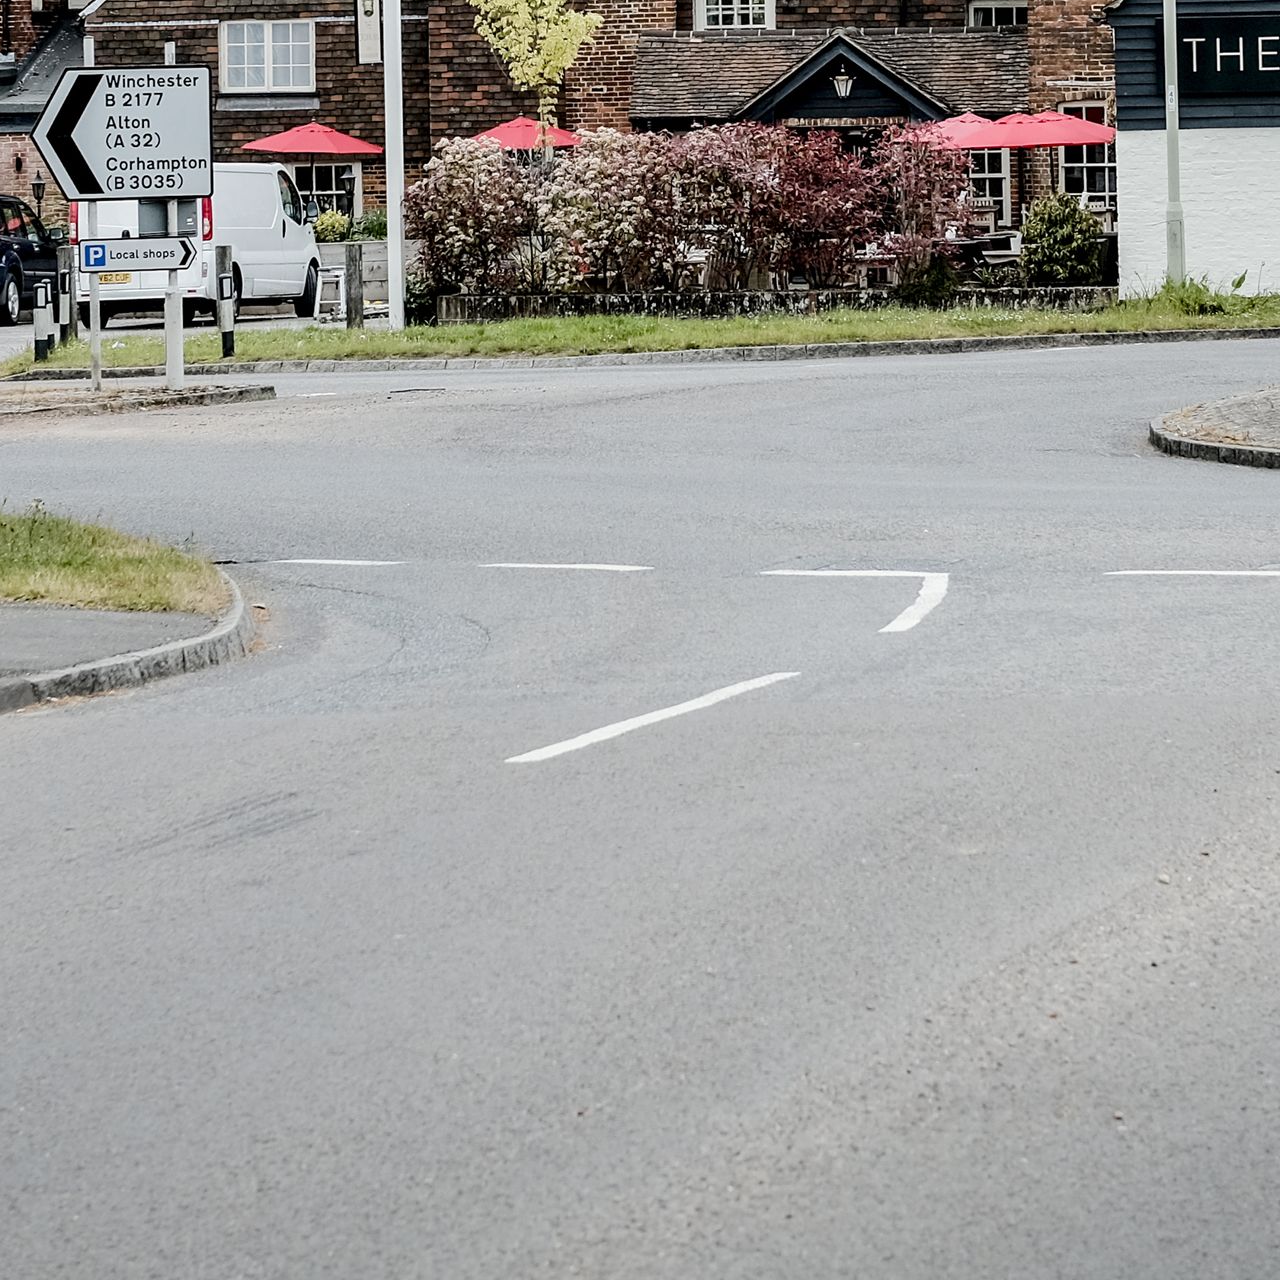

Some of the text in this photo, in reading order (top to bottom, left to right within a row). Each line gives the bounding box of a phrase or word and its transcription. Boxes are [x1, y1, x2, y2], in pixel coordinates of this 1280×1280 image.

[1183, 36, 1280, 73] THE
[106, 74, 199, 88] Winchester
[106, 93, 163, 107] B 2177
[106, 116, 150, 129] Alton
[106, 132, 161, 149] (A 32)
[106, 156, 207, 172] Corhampton
[106, 173, 183, 191] (B 3035)
[89, 247, 175, 264] P Local shops
